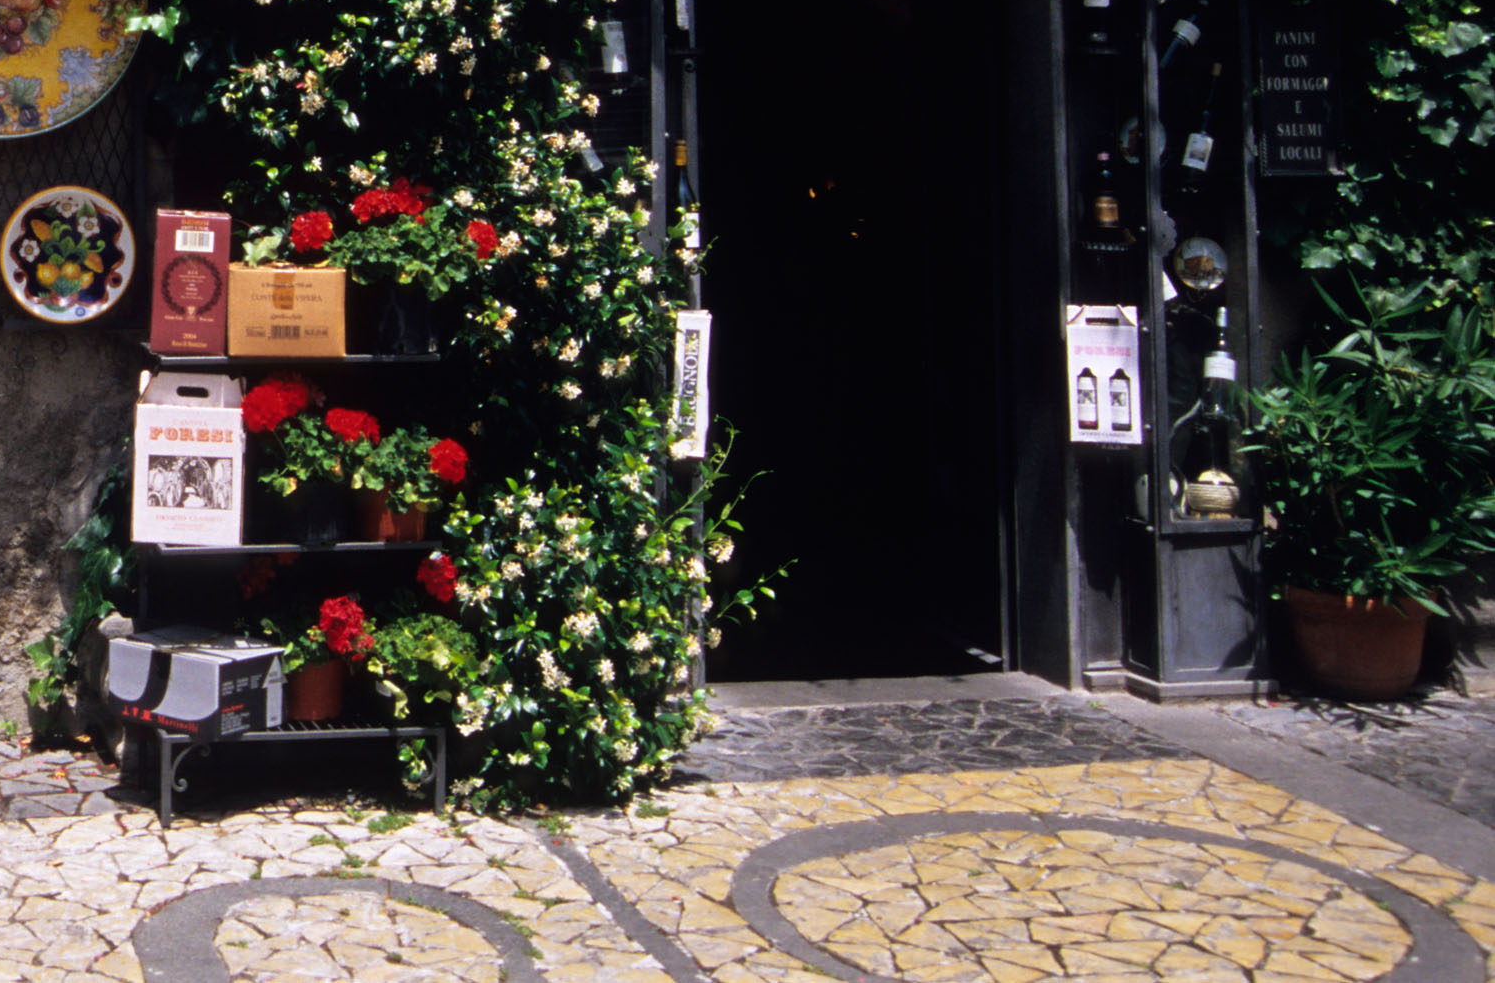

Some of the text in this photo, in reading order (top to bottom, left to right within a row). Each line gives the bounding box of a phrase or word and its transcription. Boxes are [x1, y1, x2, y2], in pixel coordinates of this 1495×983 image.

[1274, 31, 1316, 45] PANINI
[1284, 54, 1308, 67] CON
[1294, 100, 1302, 114] E
[1276, 123, 1322, 137] SALUMI
[1279, 145, 1322, 160] LOCALI
[148, 426, 234, 443] FORESI
